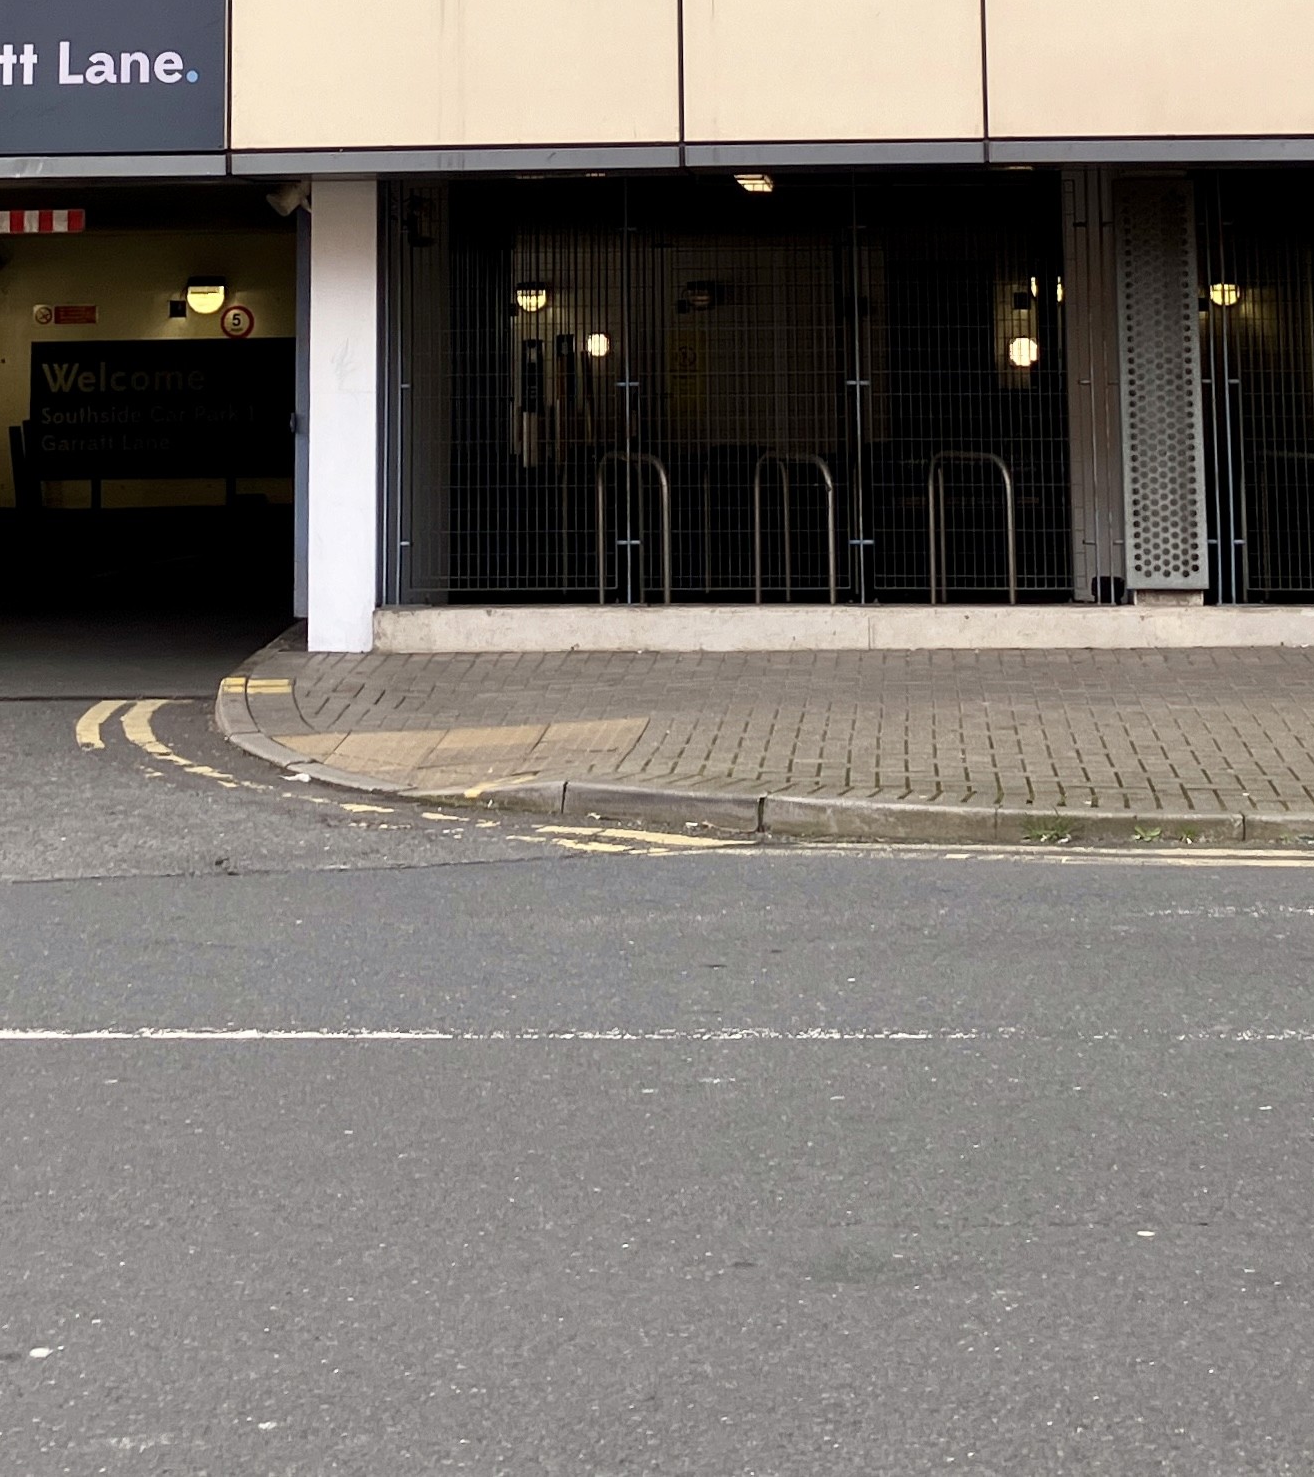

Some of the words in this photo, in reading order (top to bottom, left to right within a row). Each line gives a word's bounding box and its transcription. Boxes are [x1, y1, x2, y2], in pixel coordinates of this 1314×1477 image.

[58, 40, 200, 86] Lane.
[232, 313, 242, 327] 5
[41, 362, 206, 393] Welcome
[41, 406, 142, 425] Southside
[150, 406, 186, 423] Car
[194, 404, 238, 421] Park
[41, 434, 114, 452] Garratt
